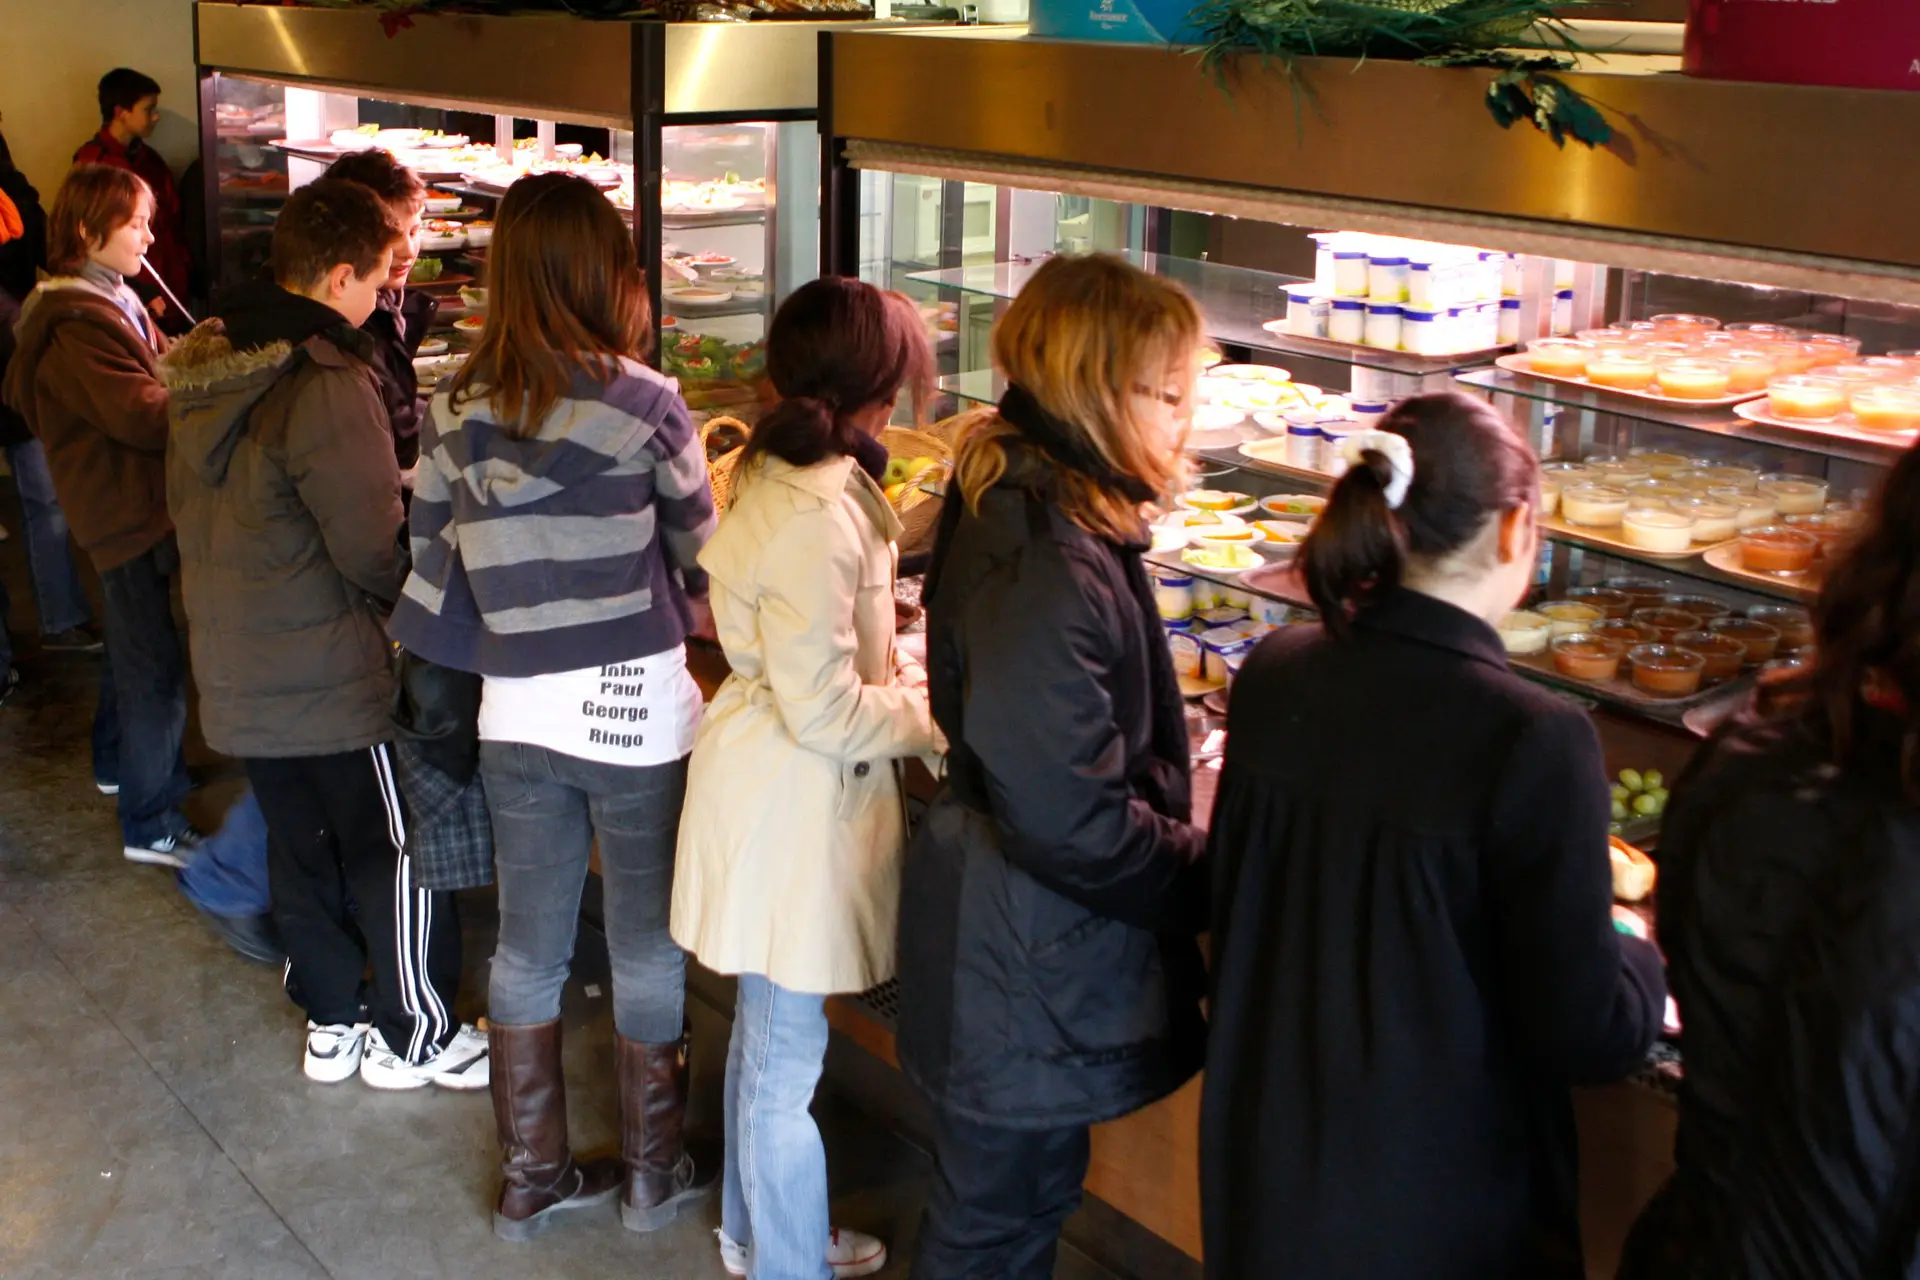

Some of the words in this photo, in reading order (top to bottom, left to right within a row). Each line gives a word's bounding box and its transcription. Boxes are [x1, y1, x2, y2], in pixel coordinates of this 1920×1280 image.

[600, 682, 643, 697] Paul
[582, 700, 648, 722] George
[589, 728, 643, 748] Ringo
